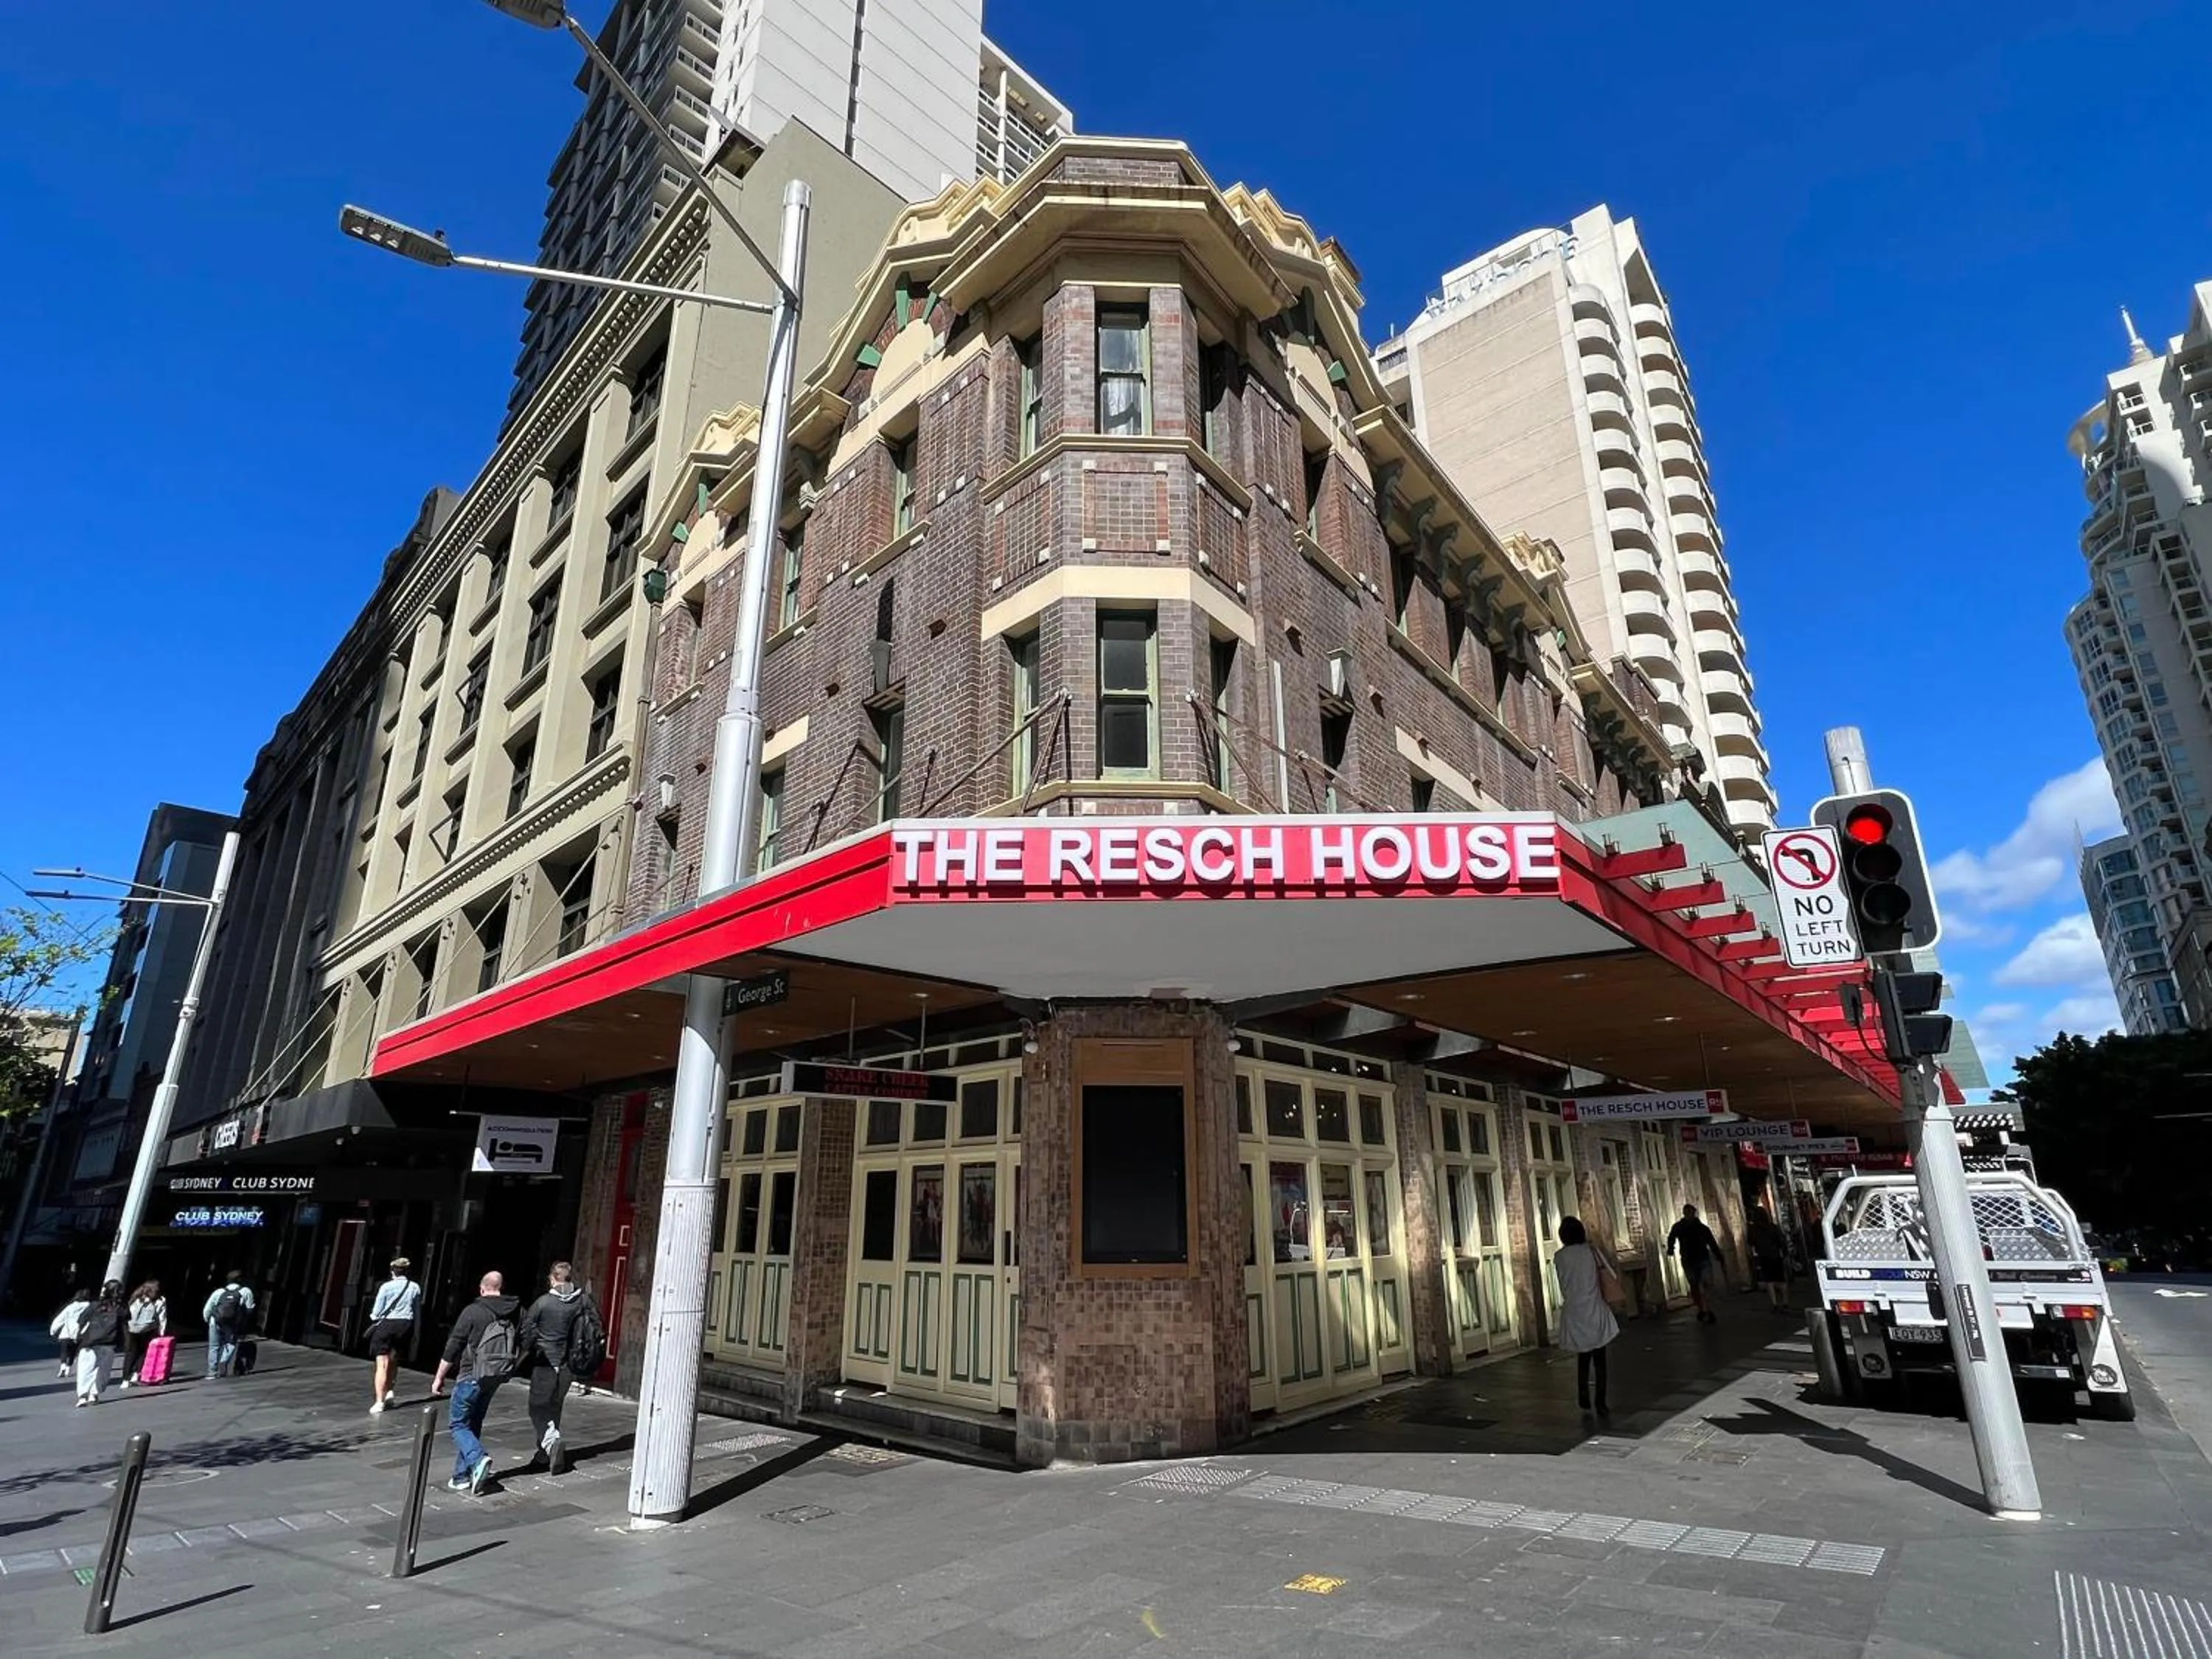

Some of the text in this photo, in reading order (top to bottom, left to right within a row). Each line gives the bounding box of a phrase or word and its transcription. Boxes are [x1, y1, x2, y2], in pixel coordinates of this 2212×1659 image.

[894, 825, 1560, 883] THE RESCH HOUSE
[1794, 894, 1834, 916] NO
[1795, 919, 1843, 936] LEFT
[1797, 939, 1851, 956] TURN
[738, 985, 772, 1004] George
[774, 978, 785, 995] St
[824, 1069, 877, 1083] SNAKE
[1579, 1106, 1605, 1116] THE
[1608, 1102, 1652, 1113] RESCH
[1656, 1098, 1705, 1110] HOUSE
[1699, 1126, 1724, 1138] VIP
[1727, 1124, 1789, 1137] LOUNGE
[185, 1178, 222, 1189] SYDNEY
[232, 1178, 267, 1189] CLUB
[175, 1211, 264, 1222] CLUB SYDNEY
[1835, 1269, 1871, 1279] BUILD
[1905, 1270, 1930, 1279] NSW
